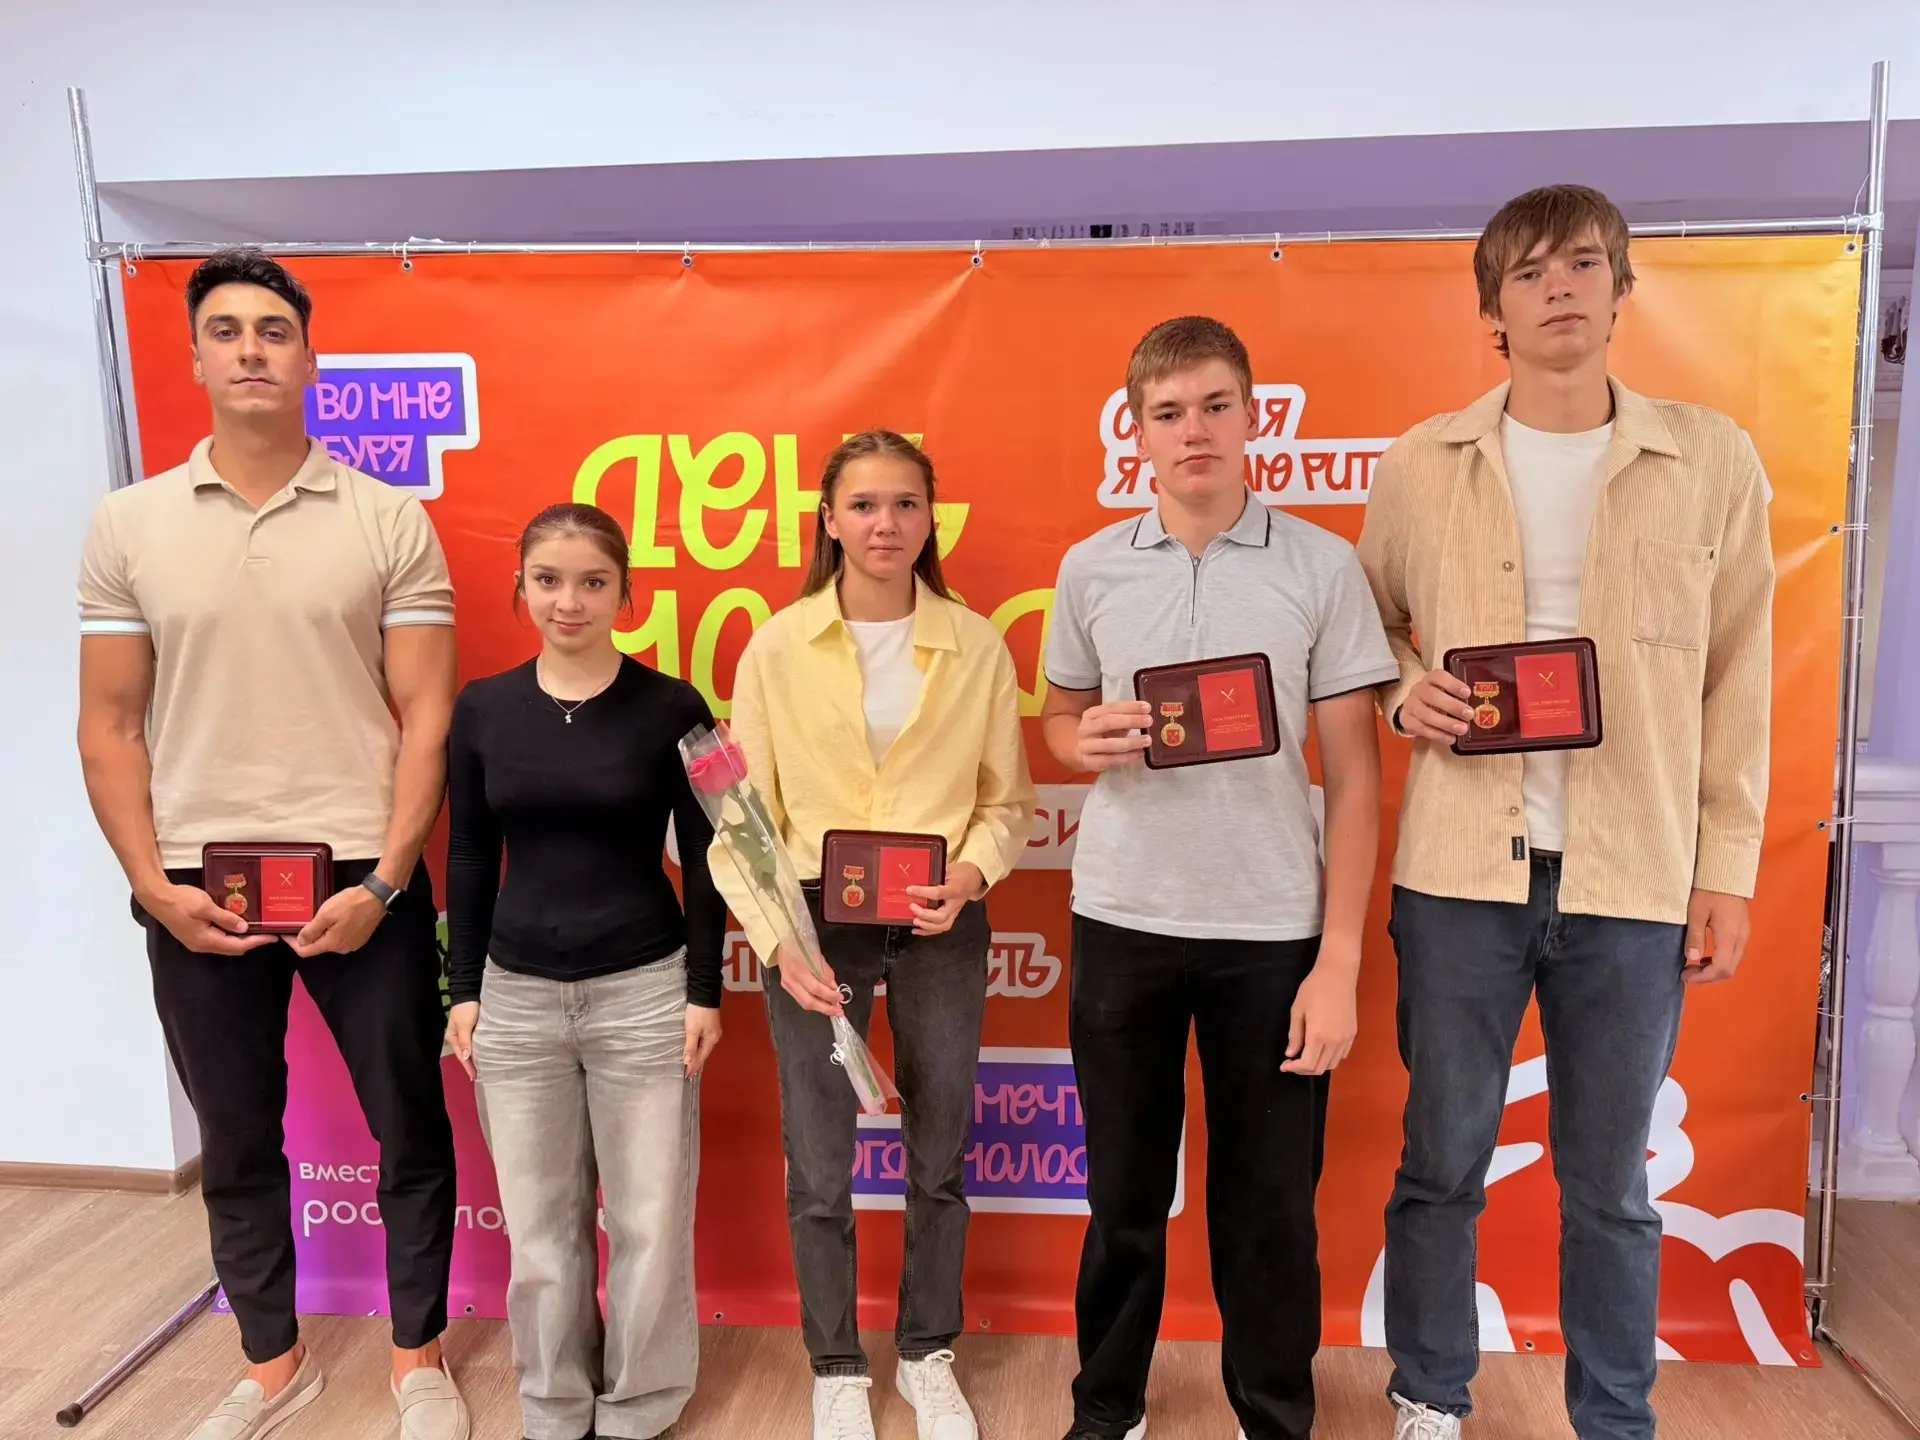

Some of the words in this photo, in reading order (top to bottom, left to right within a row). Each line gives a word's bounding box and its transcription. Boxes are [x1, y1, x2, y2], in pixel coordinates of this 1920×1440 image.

[315, 382, 364, 421] ВО
[320, 434, 415, 472] БУРЯ
[1301, 451, 1387, 492] РИТ
